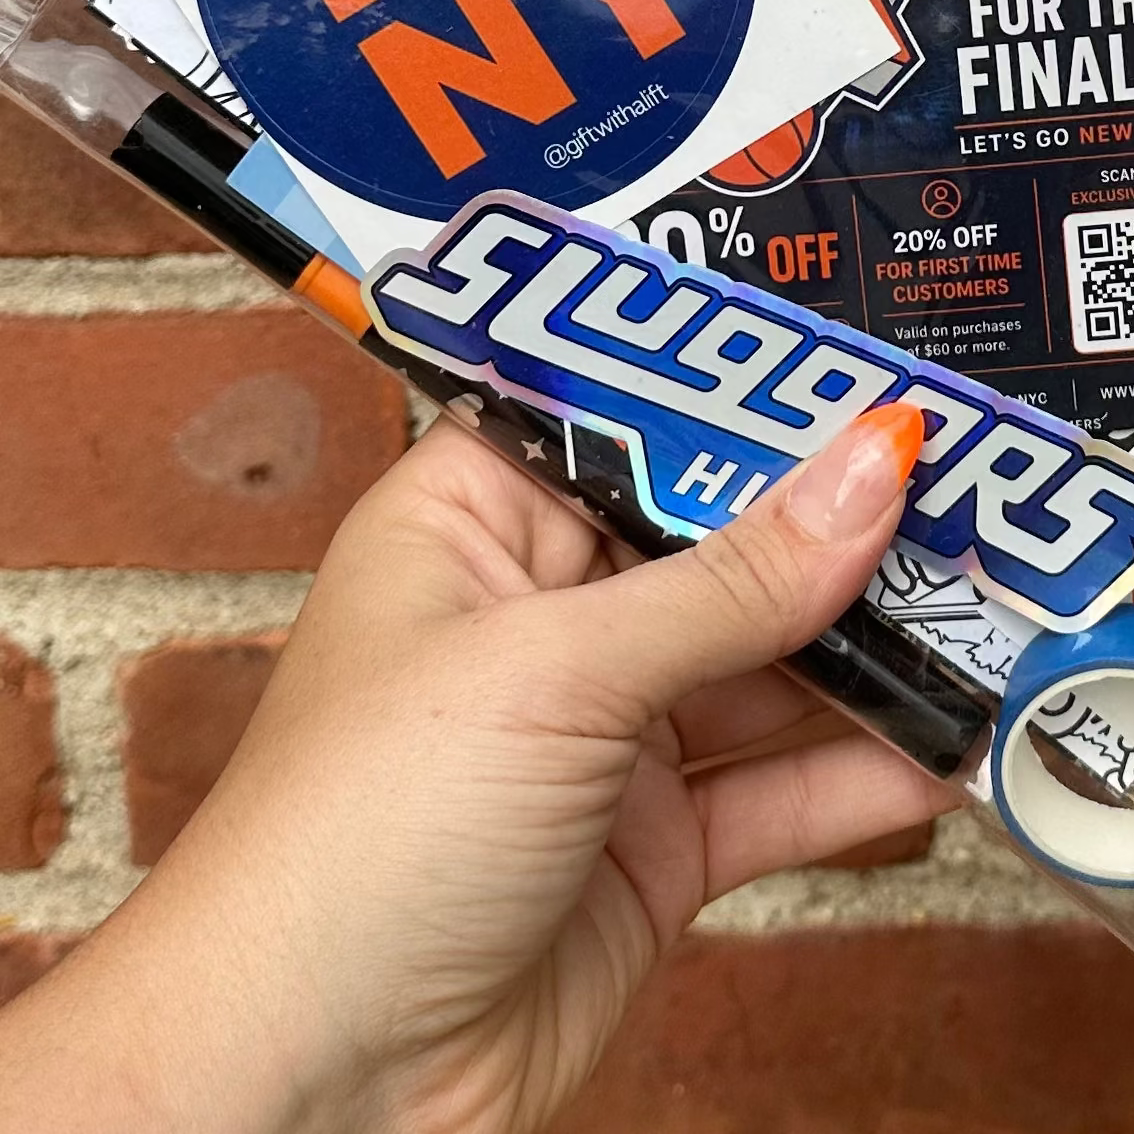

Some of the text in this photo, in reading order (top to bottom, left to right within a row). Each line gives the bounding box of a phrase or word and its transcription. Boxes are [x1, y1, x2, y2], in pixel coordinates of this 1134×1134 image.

[542, 80, 671, 170] @giftwithalift
[959, 128, 1027, 155] LET'S
[1035, 127, 1070, 149] GO
[1078, 124, 1133, 145] NEW
[892, 223, 998, 254] 20% OFF
[766, 231, 839, 283] OFF
[875, 251, 1022, 282] FOR FIRST TIME
[892, 278, 1010, 304] CUSTOMERS
[894, 319, 1022, 340] Valid on purchases
[924, 341, 950, 357] $60
[954, 343, 969, 354] or
[972, 339, 1011, 353] more.
